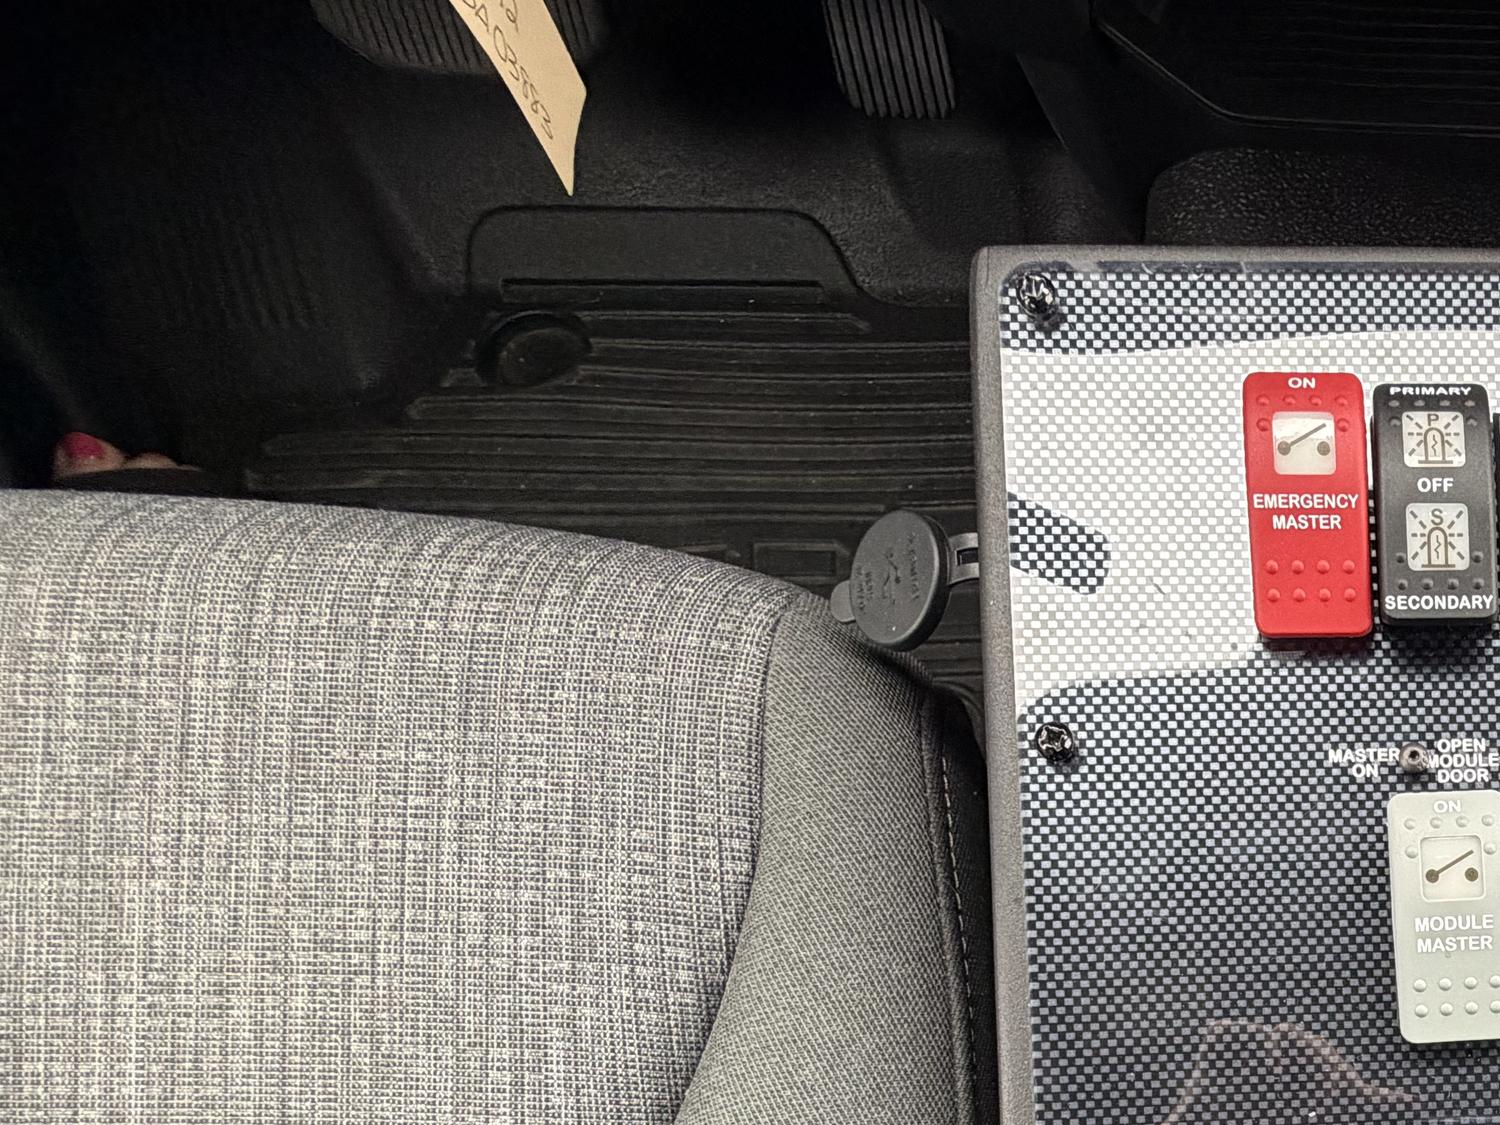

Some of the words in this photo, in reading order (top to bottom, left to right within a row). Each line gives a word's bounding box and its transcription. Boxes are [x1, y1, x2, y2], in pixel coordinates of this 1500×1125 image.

[1287, 377, 1316, 390] ON
[1389, 386, 1472, 396] PRIMARY
[1427, 413, 1440, 427] P
[1417, 477, 1454, 493] OFF
[1252, 494, 1359, 509] EMERGENCY
[1272, 514, 1342, 530] MASTER
[1430, 508, 1445, 526] S
[1384, 594, 1494, 610] SECONDARY
[1436, 738, 1487, 752] OPEN
[1328, 748, 1400, 763] MASTER
[1428, 752, 1500, 768] MODULE
[1351, 763, 1379, 778] ON
[1437, 768, 1489, 783] DOOR
[1432, 800, 1463, 814] ON
[1414, 913, 1495, 933] MODULE
[1416, 935, 1494, 954] MASTER
